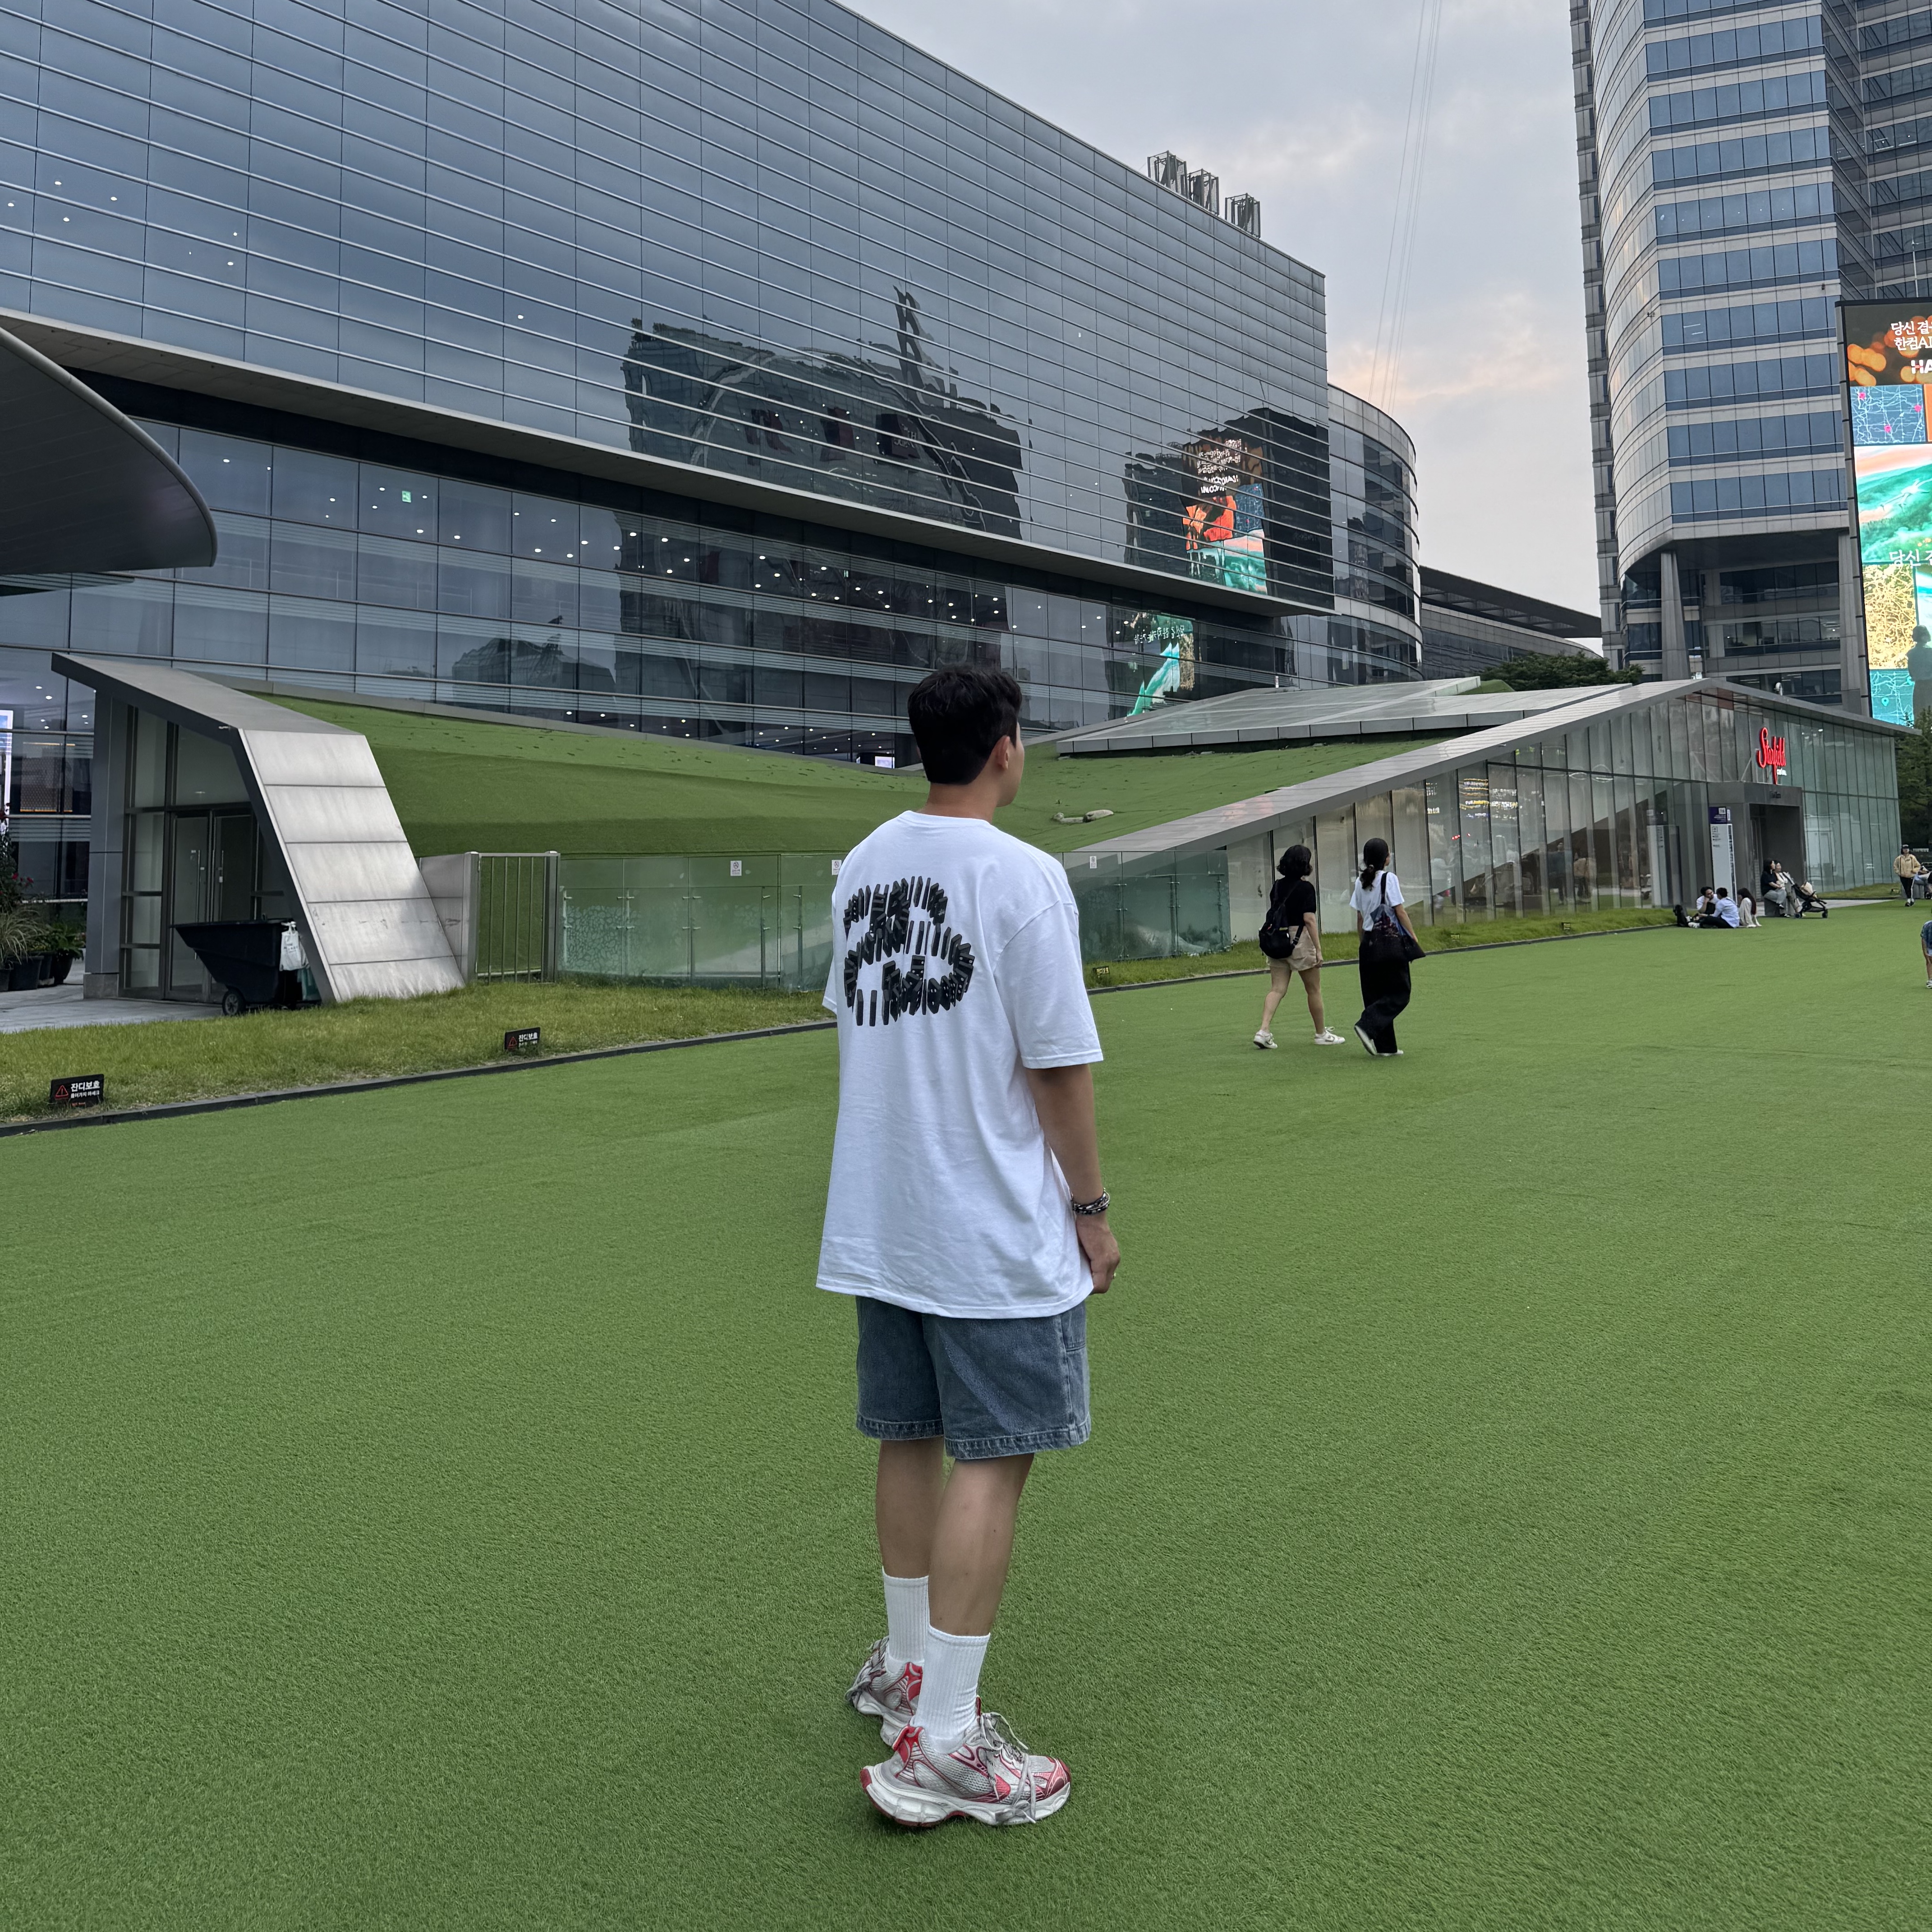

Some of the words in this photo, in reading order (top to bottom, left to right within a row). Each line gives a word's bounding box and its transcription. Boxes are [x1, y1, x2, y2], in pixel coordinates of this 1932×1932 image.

[1891, 321, 1916, 336] 당신
[1917, 320, 1932, 335] 곁
[1889, 549, 1921, 566] 당신
[71, 1080, 100, 1092] 잔디보호
